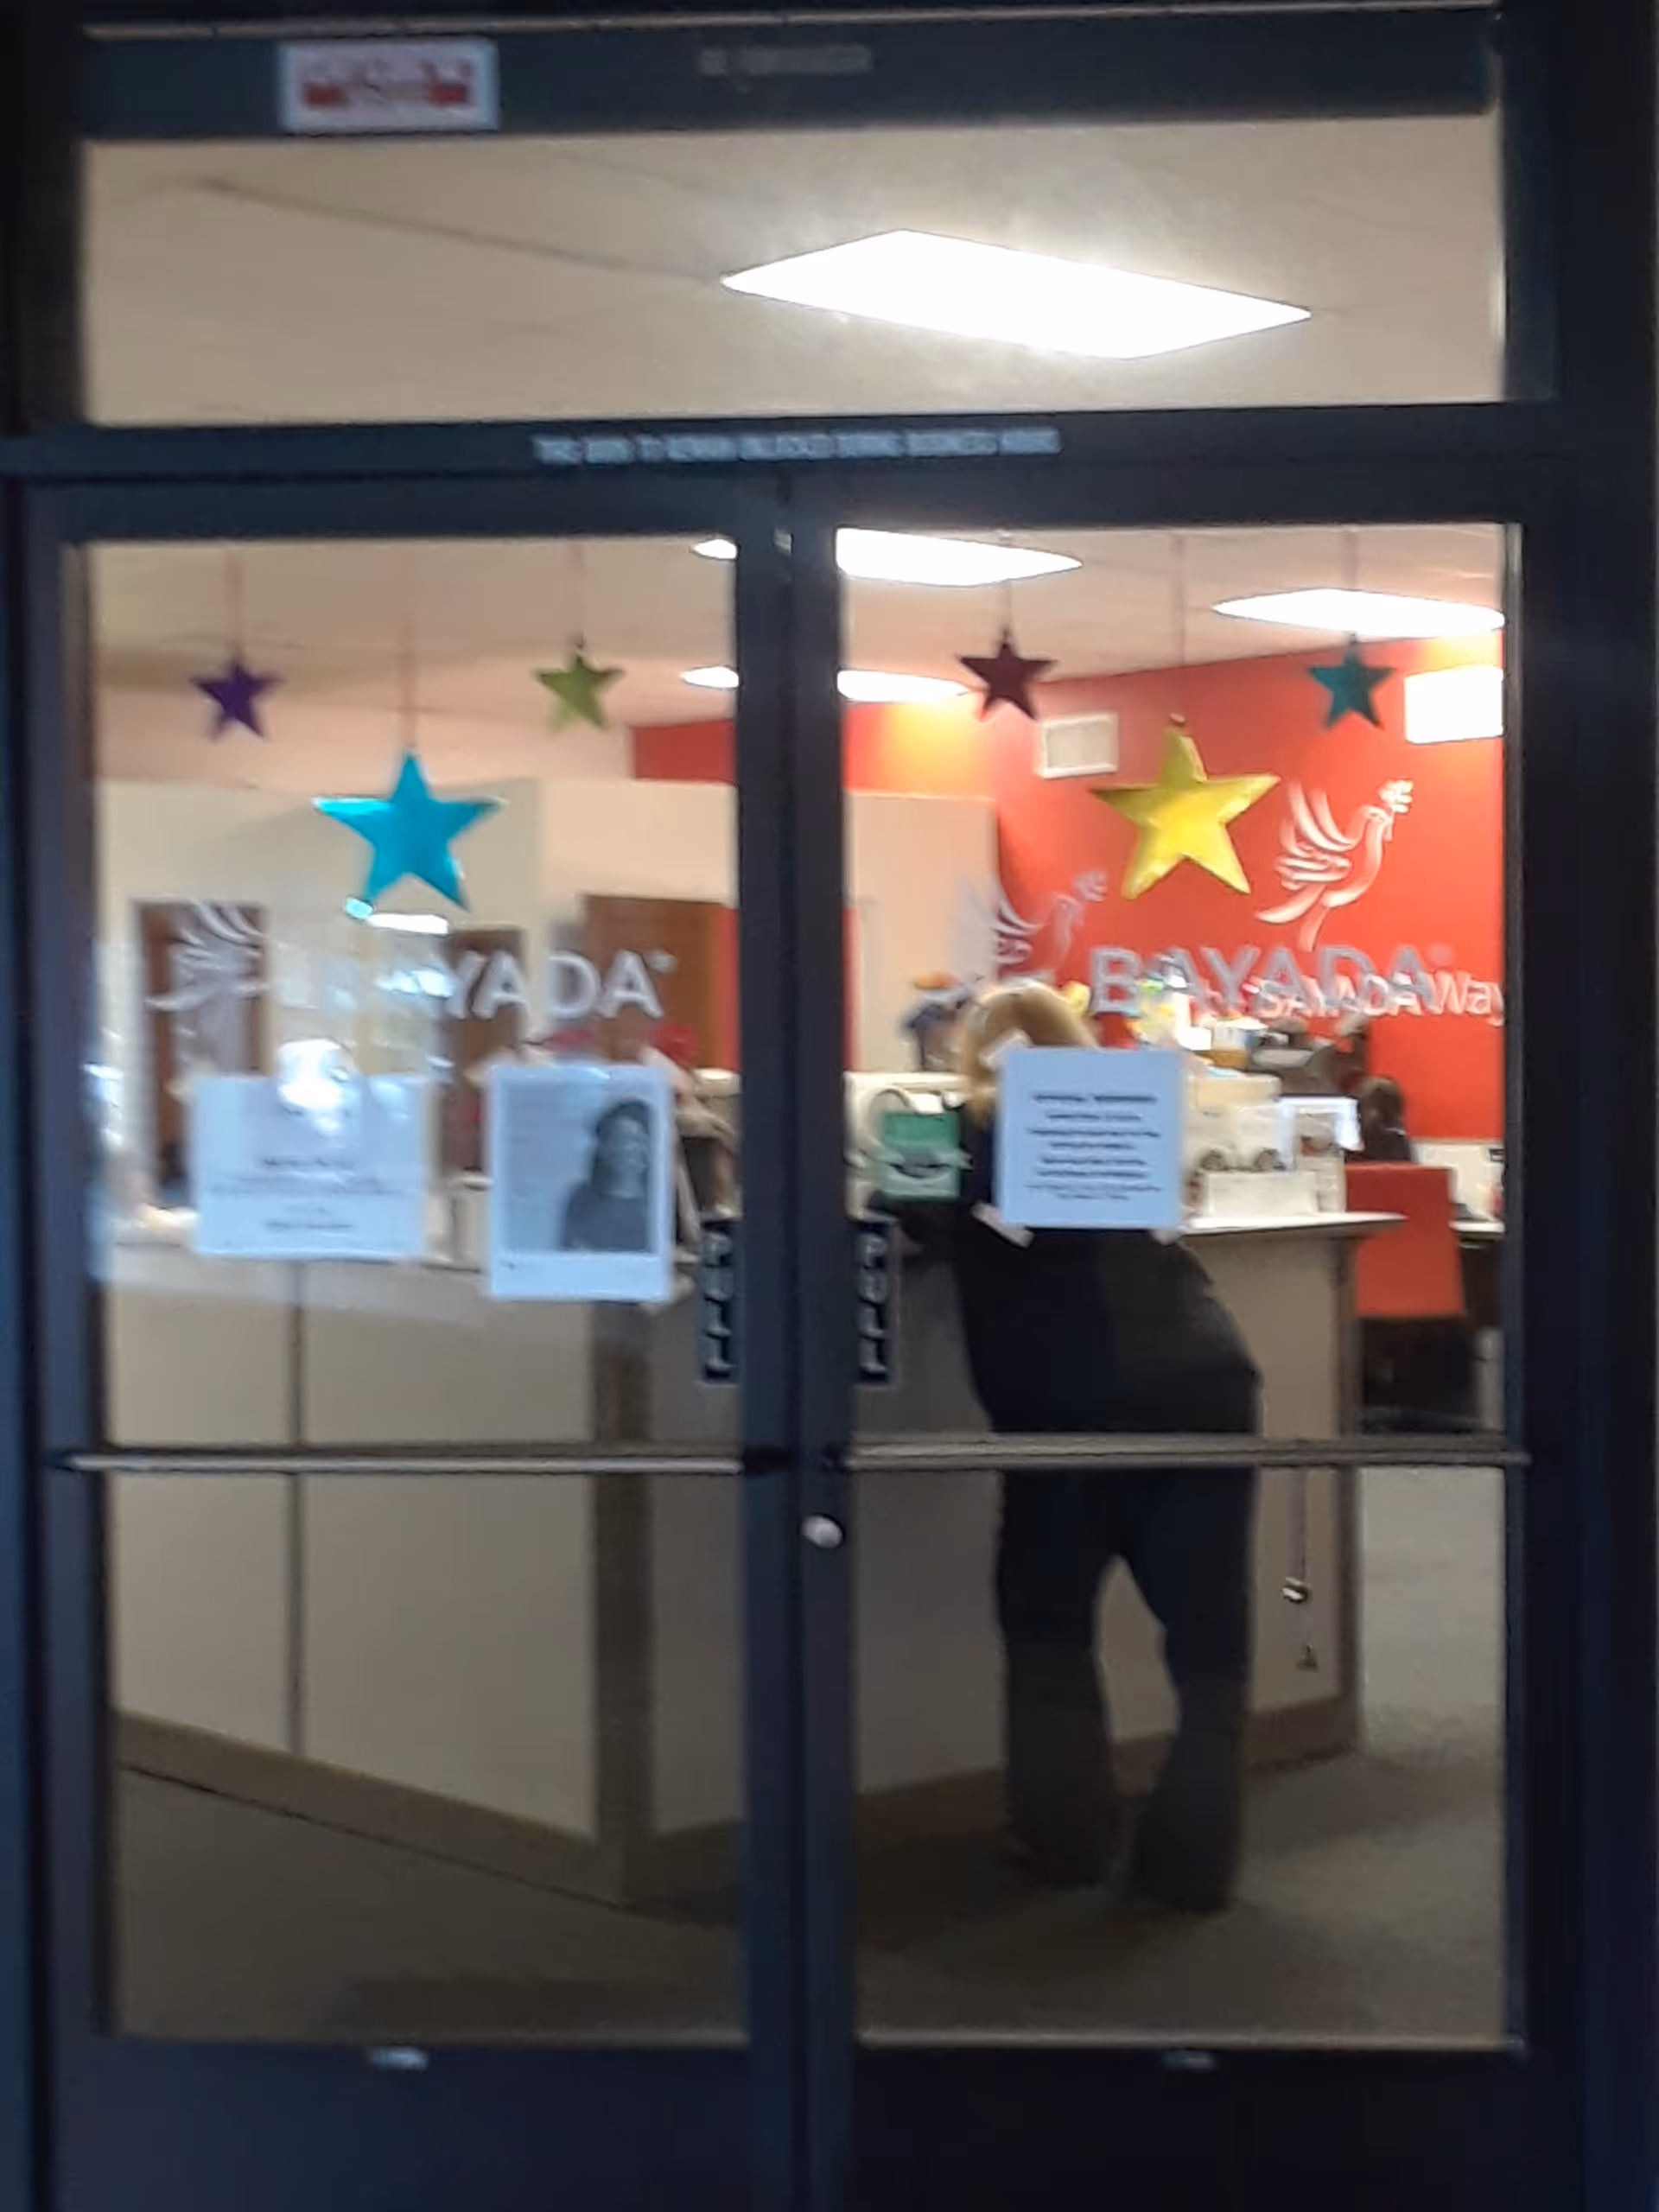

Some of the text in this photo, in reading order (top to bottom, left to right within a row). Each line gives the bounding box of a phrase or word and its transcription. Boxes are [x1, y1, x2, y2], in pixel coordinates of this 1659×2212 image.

[1090, 945, 1436, 1014] BAYADA
[702, 1229, 734, 1372] PULL
[859, 1230, 888, 1374] PULL
